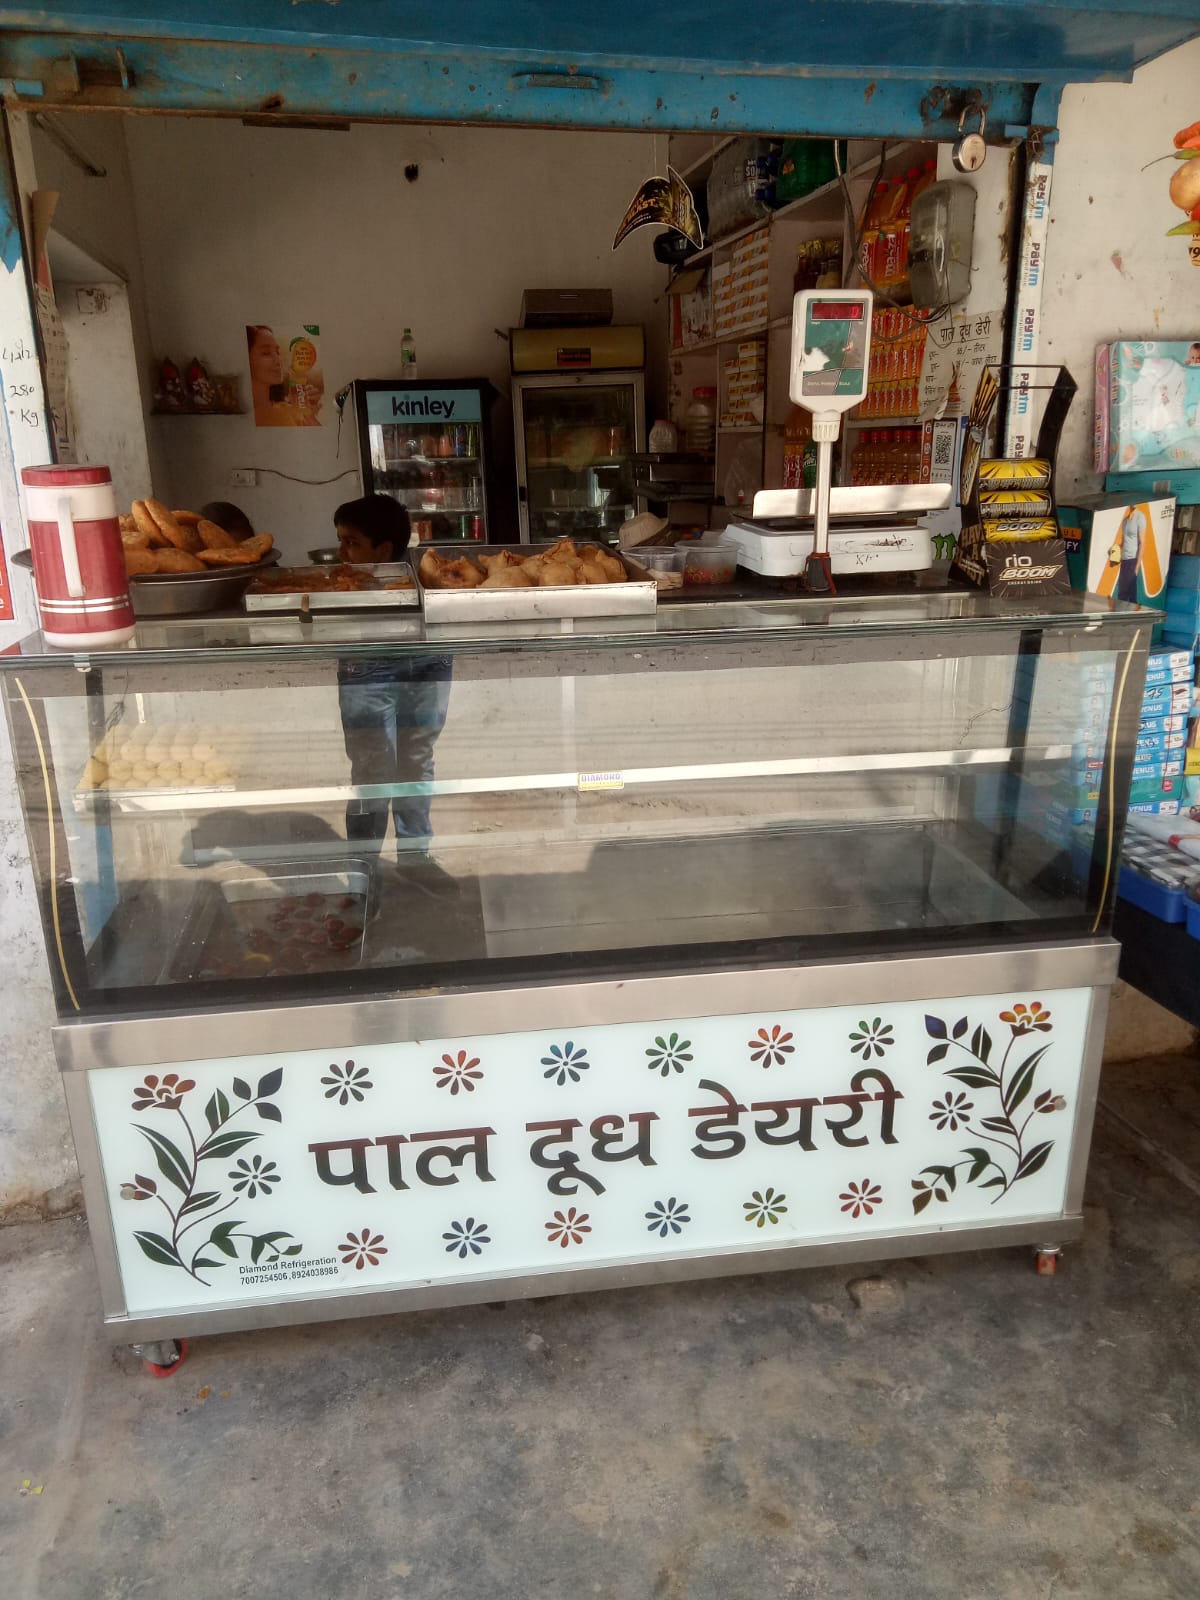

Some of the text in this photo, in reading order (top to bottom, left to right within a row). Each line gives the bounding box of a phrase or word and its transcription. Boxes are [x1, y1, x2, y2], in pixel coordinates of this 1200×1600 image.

[392, 394, 455, 418] kinley
[1005, 554, 1032, 567] rio
[1002, 567, 1058, 579] BOOM
[308, 1068, 904, 1197] पाल दूध डेयरी
[239, 1256, 337, 1274] Diamond Refrigeration
